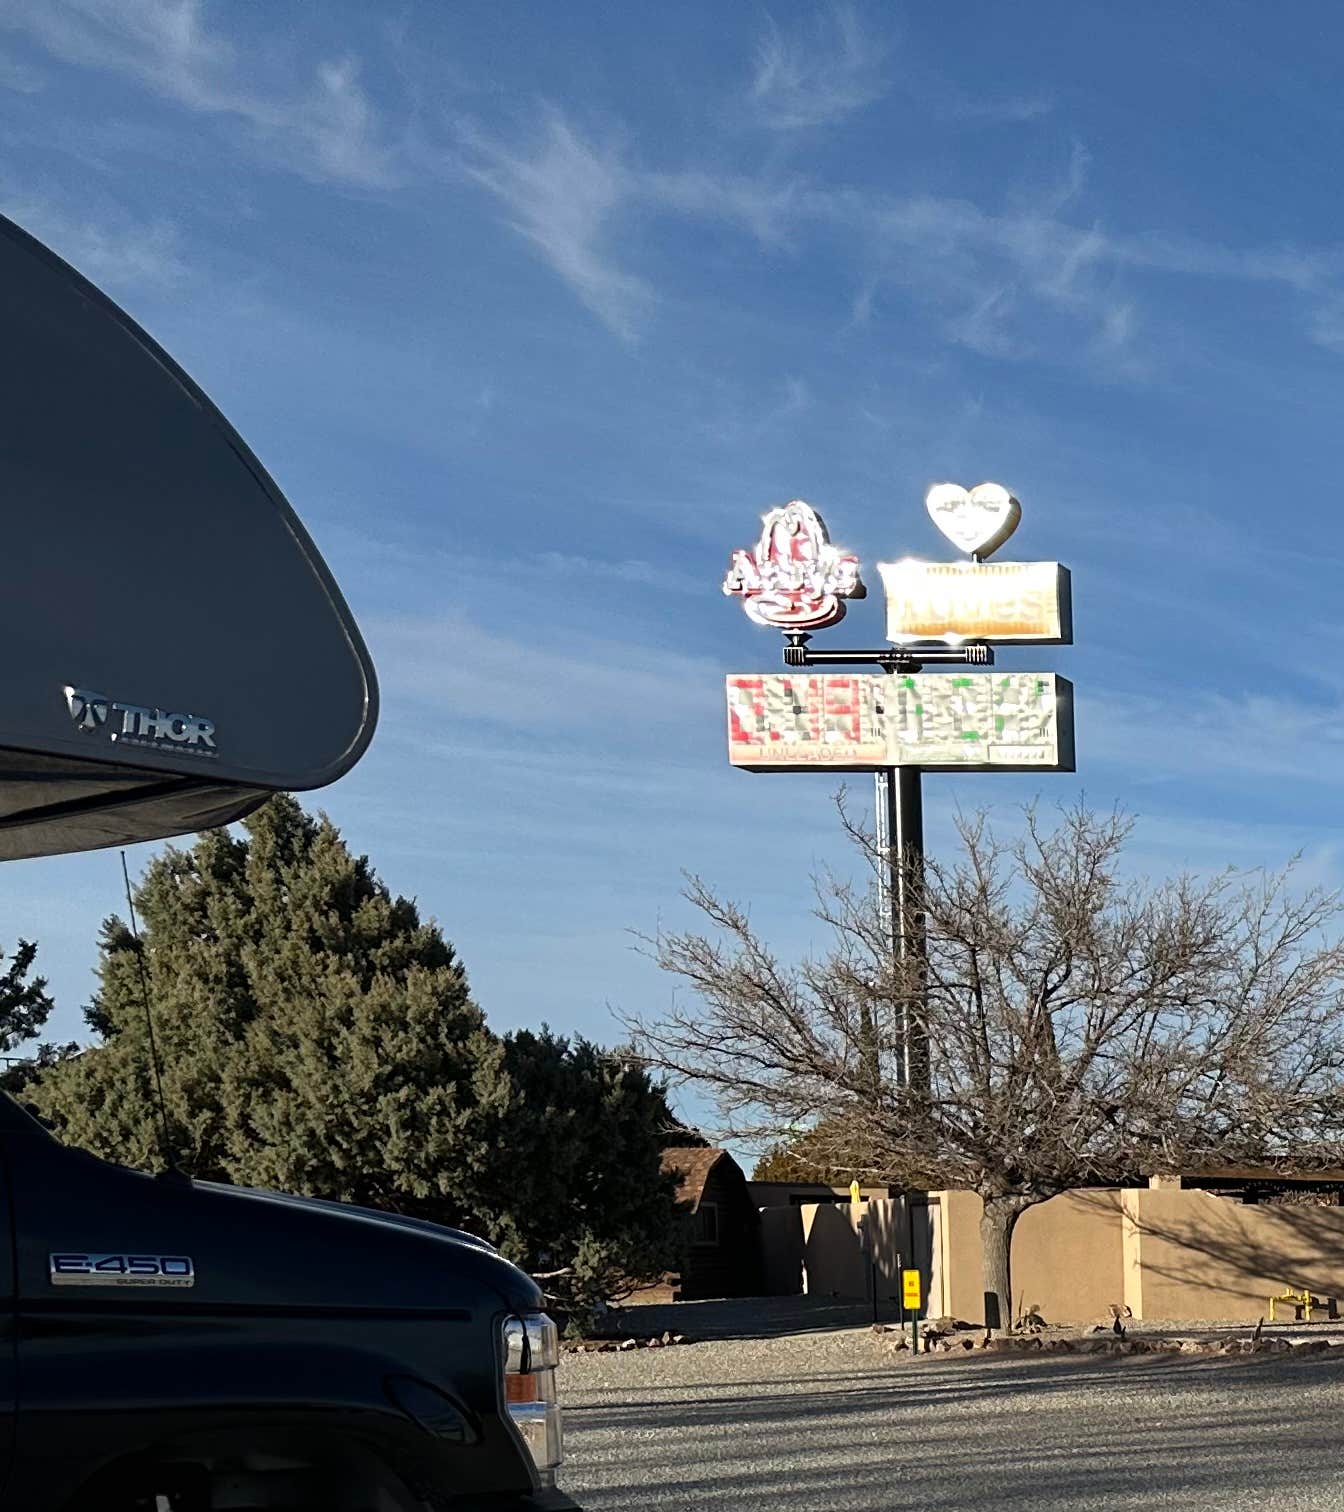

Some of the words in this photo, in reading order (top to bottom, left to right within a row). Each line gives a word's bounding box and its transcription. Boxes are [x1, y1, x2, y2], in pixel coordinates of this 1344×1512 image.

[112, 702, 217, 748] THOR
[52, 1255, 191, 1275] E-450
[159, 1278, 191, 1286] DUTY
